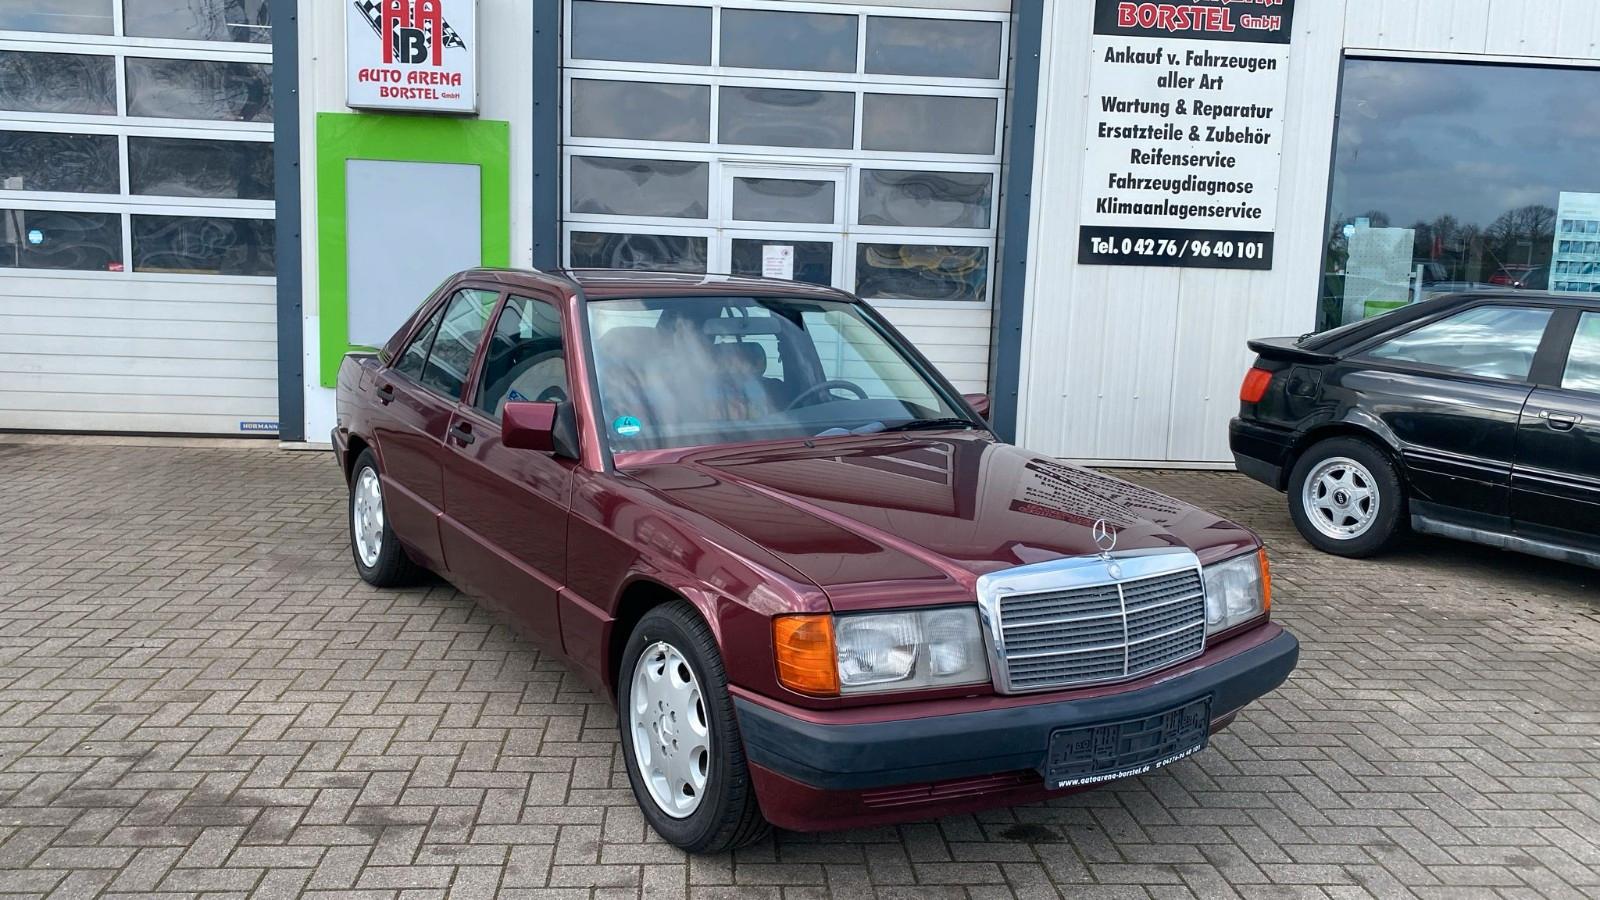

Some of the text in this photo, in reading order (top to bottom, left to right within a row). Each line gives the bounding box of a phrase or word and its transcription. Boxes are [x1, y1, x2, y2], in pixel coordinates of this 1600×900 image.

[1118, 2, 1282, 32] BORSTEL GmbH
[1104, 46, 1277, 72] Ankauf v. Fahrzeugen
[358, 69, 461, 86] AUTO ARENA
[1157, 71, 1223, 90] aller Art
[380, 86, 439, 99] BORSTEL
[1101, 96, 1273, 119] Wartung & Reparatur
[1098, 122, 1271, 145] Ersatzteile & Zubehör
[1130, 148, 1236, 168] Reifenservice
[1109, 172, 1253, 195] Fahrzeugdiagnose
[1096, 197, 1262, 219] Klimaanlagenservice
[1091, 237, 1119, 254] Tel.
[1058, 765, 1150, 787] www.autoarena-borstel.de
